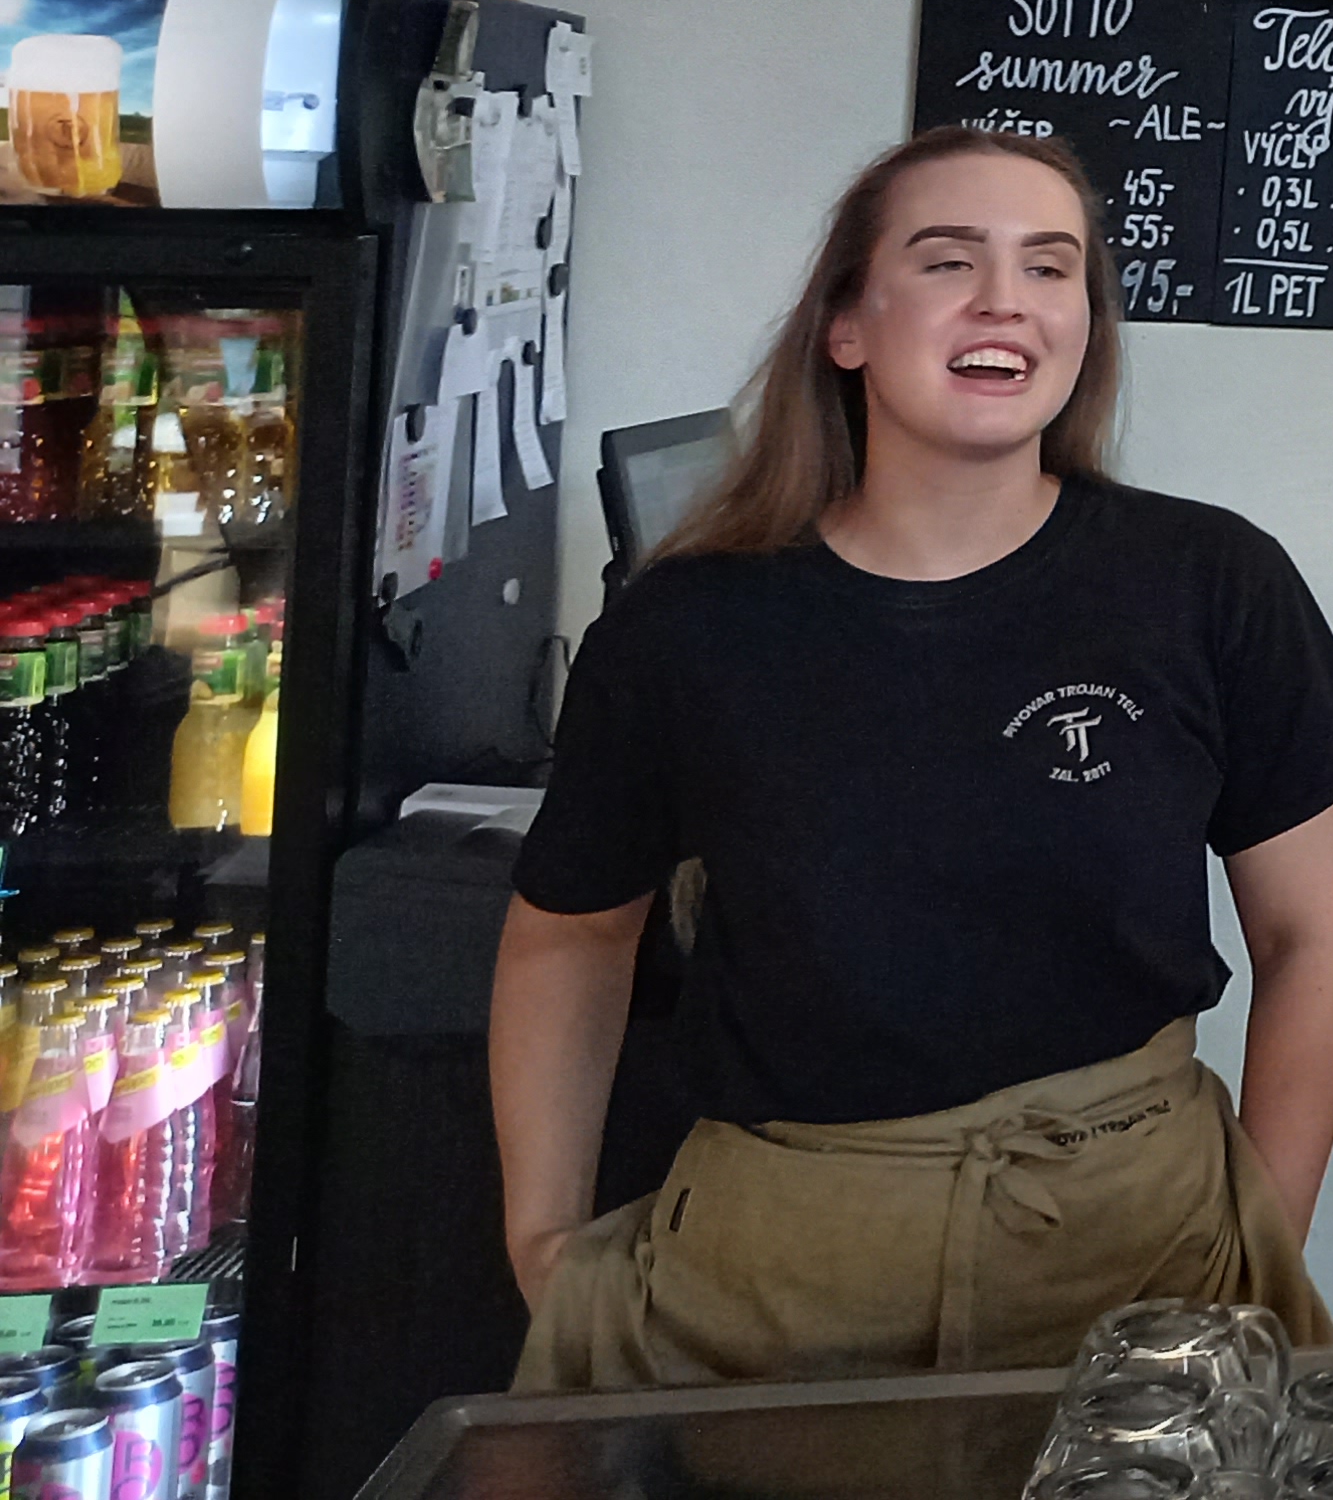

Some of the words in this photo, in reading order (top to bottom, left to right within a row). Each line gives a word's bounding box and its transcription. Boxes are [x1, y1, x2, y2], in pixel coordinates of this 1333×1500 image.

[956, 52, 1179, 99] summer
[1262, 176, 1318, 217] 0,3L
[1257, 218, 1312, 257] 0,5L
[1225, 272, 1260, 314] 1L
[1268, 274, 1325, 317] PET
[1003, 691, 1056, 738] PIVOVAR
[1057, 683, 1117, 699] TROJAN
[1116, 694, 1144, 721] TELČ
[1082, 761, 1111, 782] 2017
